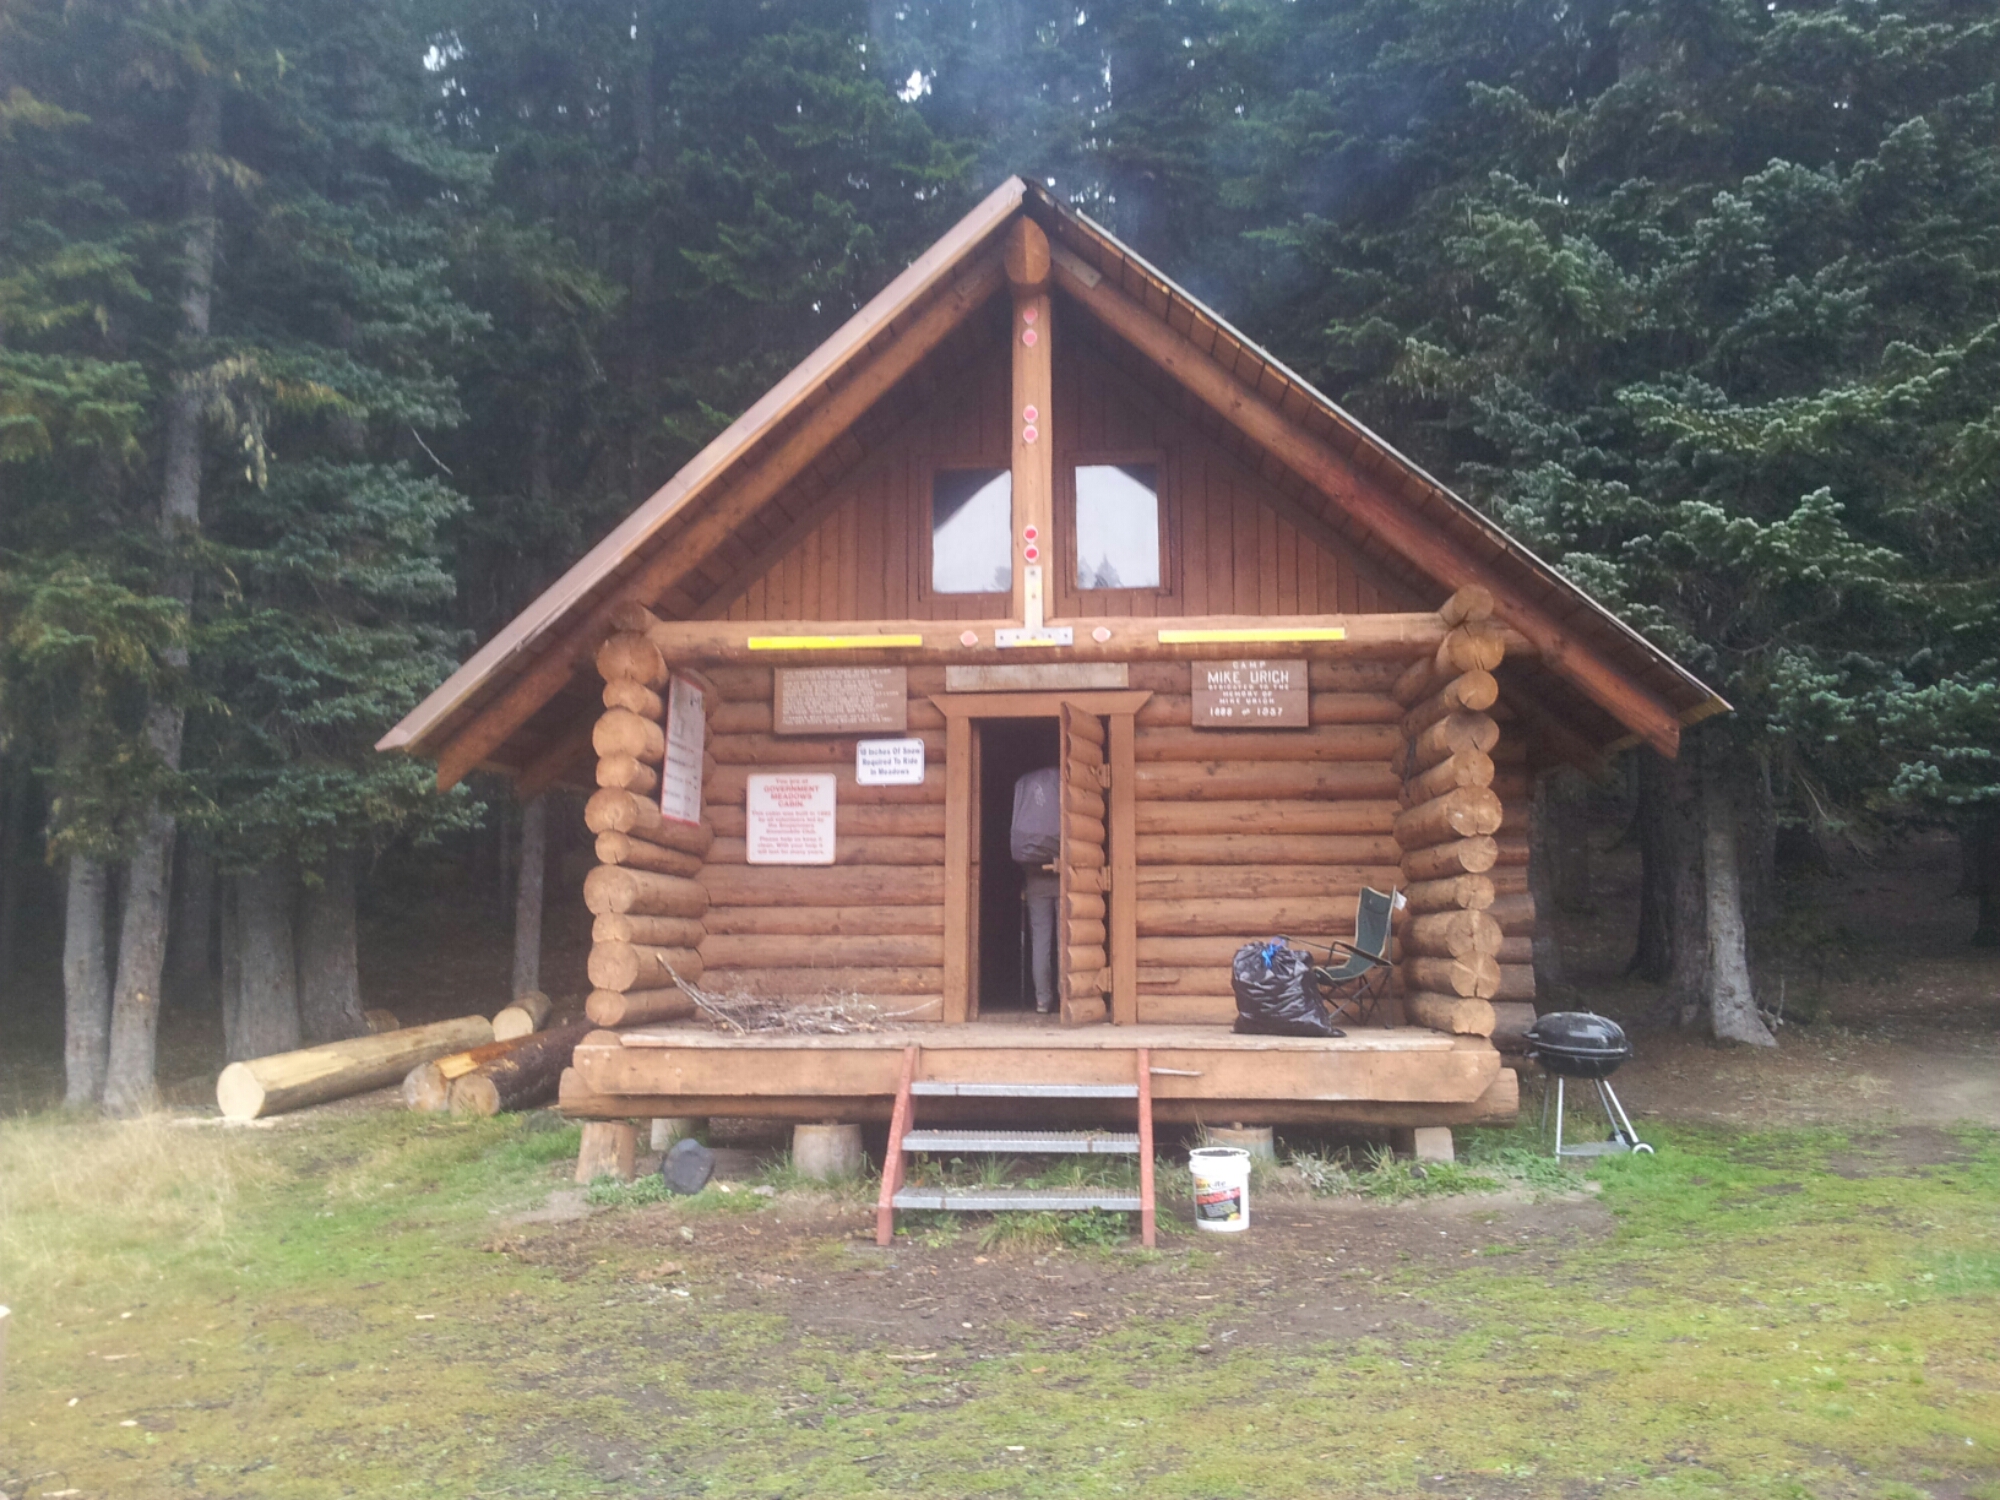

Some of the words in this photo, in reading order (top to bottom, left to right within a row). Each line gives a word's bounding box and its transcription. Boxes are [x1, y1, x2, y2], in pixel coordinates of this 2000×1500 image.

[1232, 660, 1267, 670] CAMP
[1207, 670, 1241, 684] MIKE
[1249, 670, 1289, 684] URICH
[1222, 690, 1258, 698] MEMORY
[1262, 690, 1273, 698] OF
[1245, 697, 1275, 706] URICH
[868, 747, 891, 755] Inches
[892, 746, 900, 755] Of
[902, 746, 920, 754] Snow
[862, 757, 891, 767] Required
[894, 757, 901, 765] To
[903, 756, 918, 765] Ride
[878, 767, 909, 775] Meadows
[770, 792, 813, 800] MEADOWS
